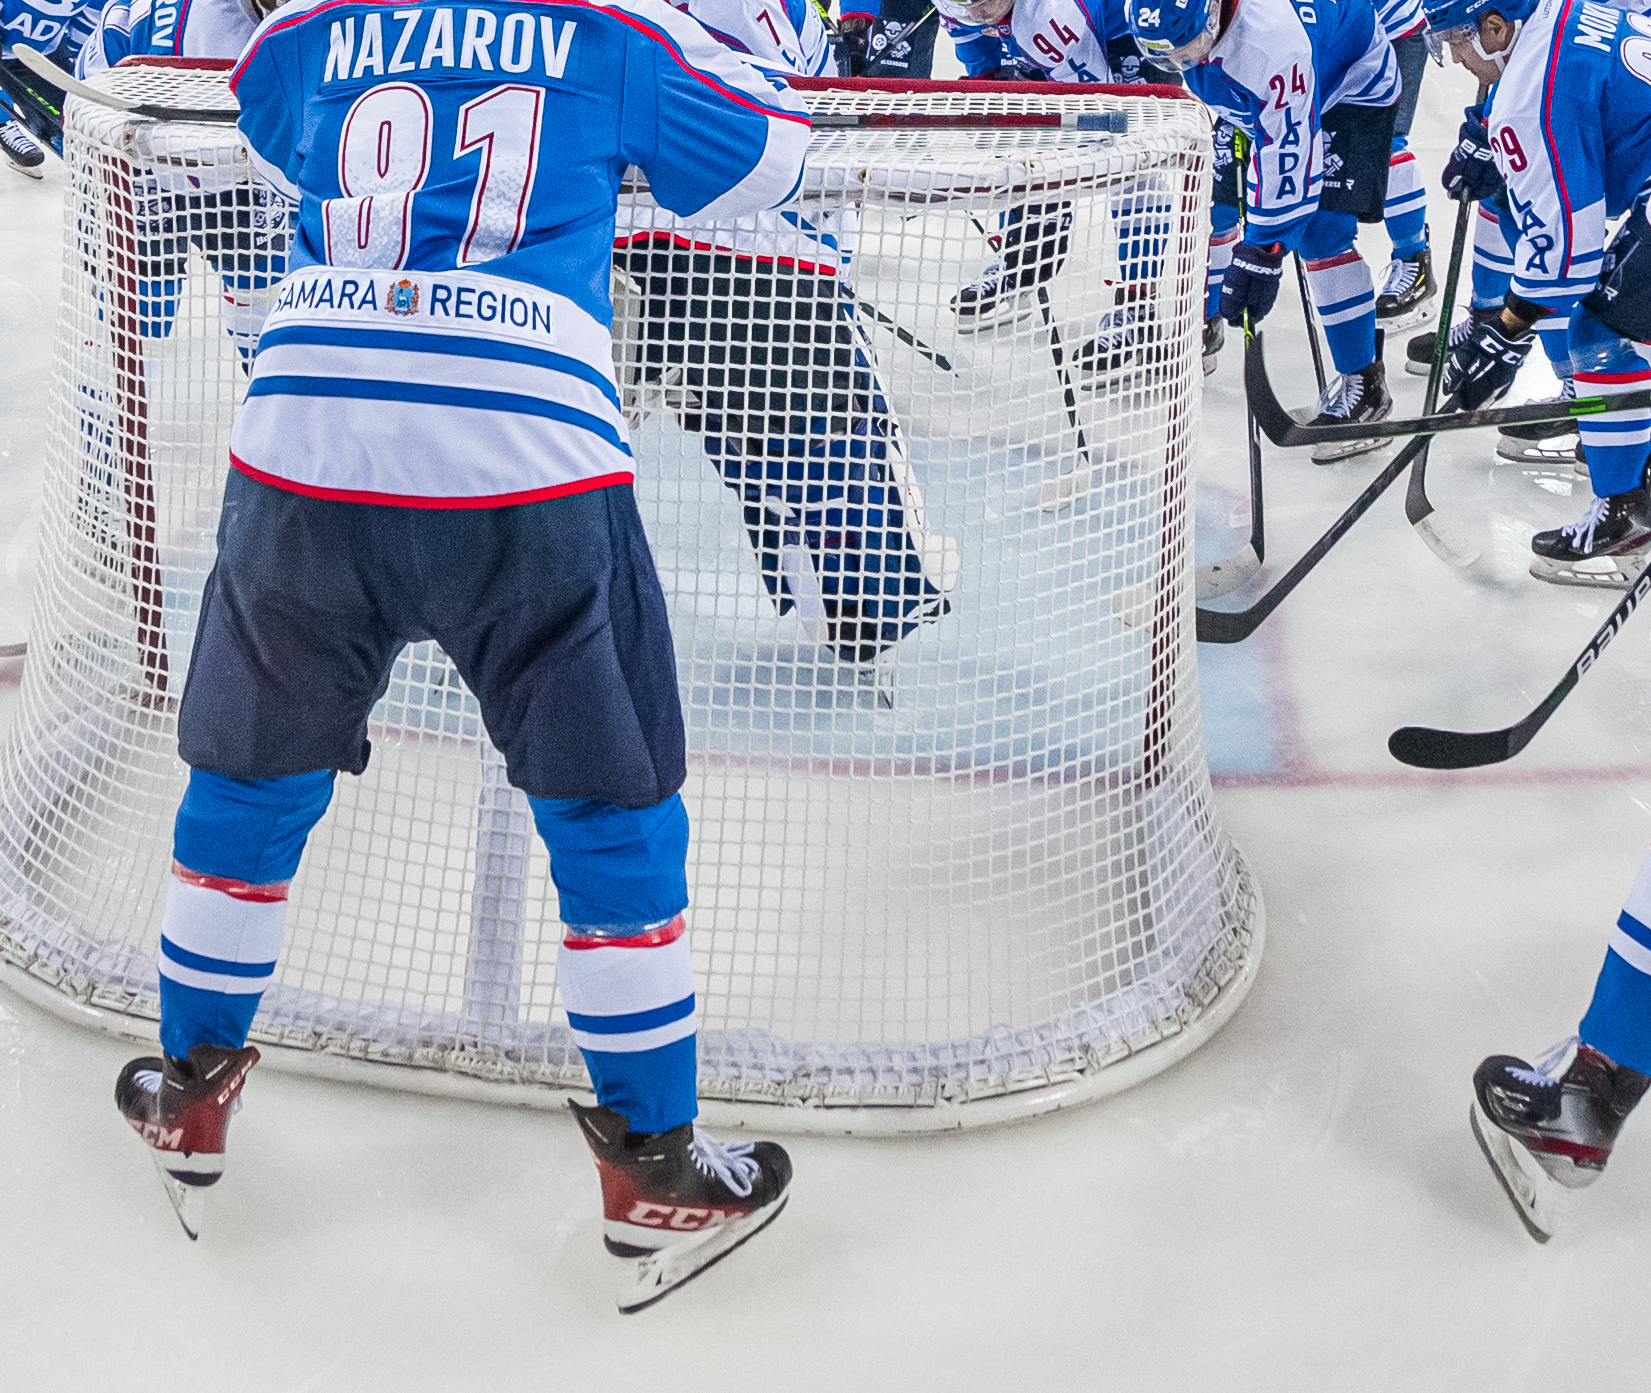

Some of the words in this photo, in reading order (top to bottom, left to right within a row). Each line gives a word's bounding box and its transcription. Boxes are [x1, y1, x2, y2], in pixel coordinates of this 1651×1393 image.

[322, 6, 578, 84] NAZAROV
[1032, 18, 1081, 64] 94
[1138, 8, 1162, 28] 24
[1267, 63, 1307, 111] 24
[1276, 108, 1302, 201] LADA
[1509, 187, 1555, 275] LADA
[273, 278, 378, 315] SAMARA
[430, 288, 552, 335] REGION
